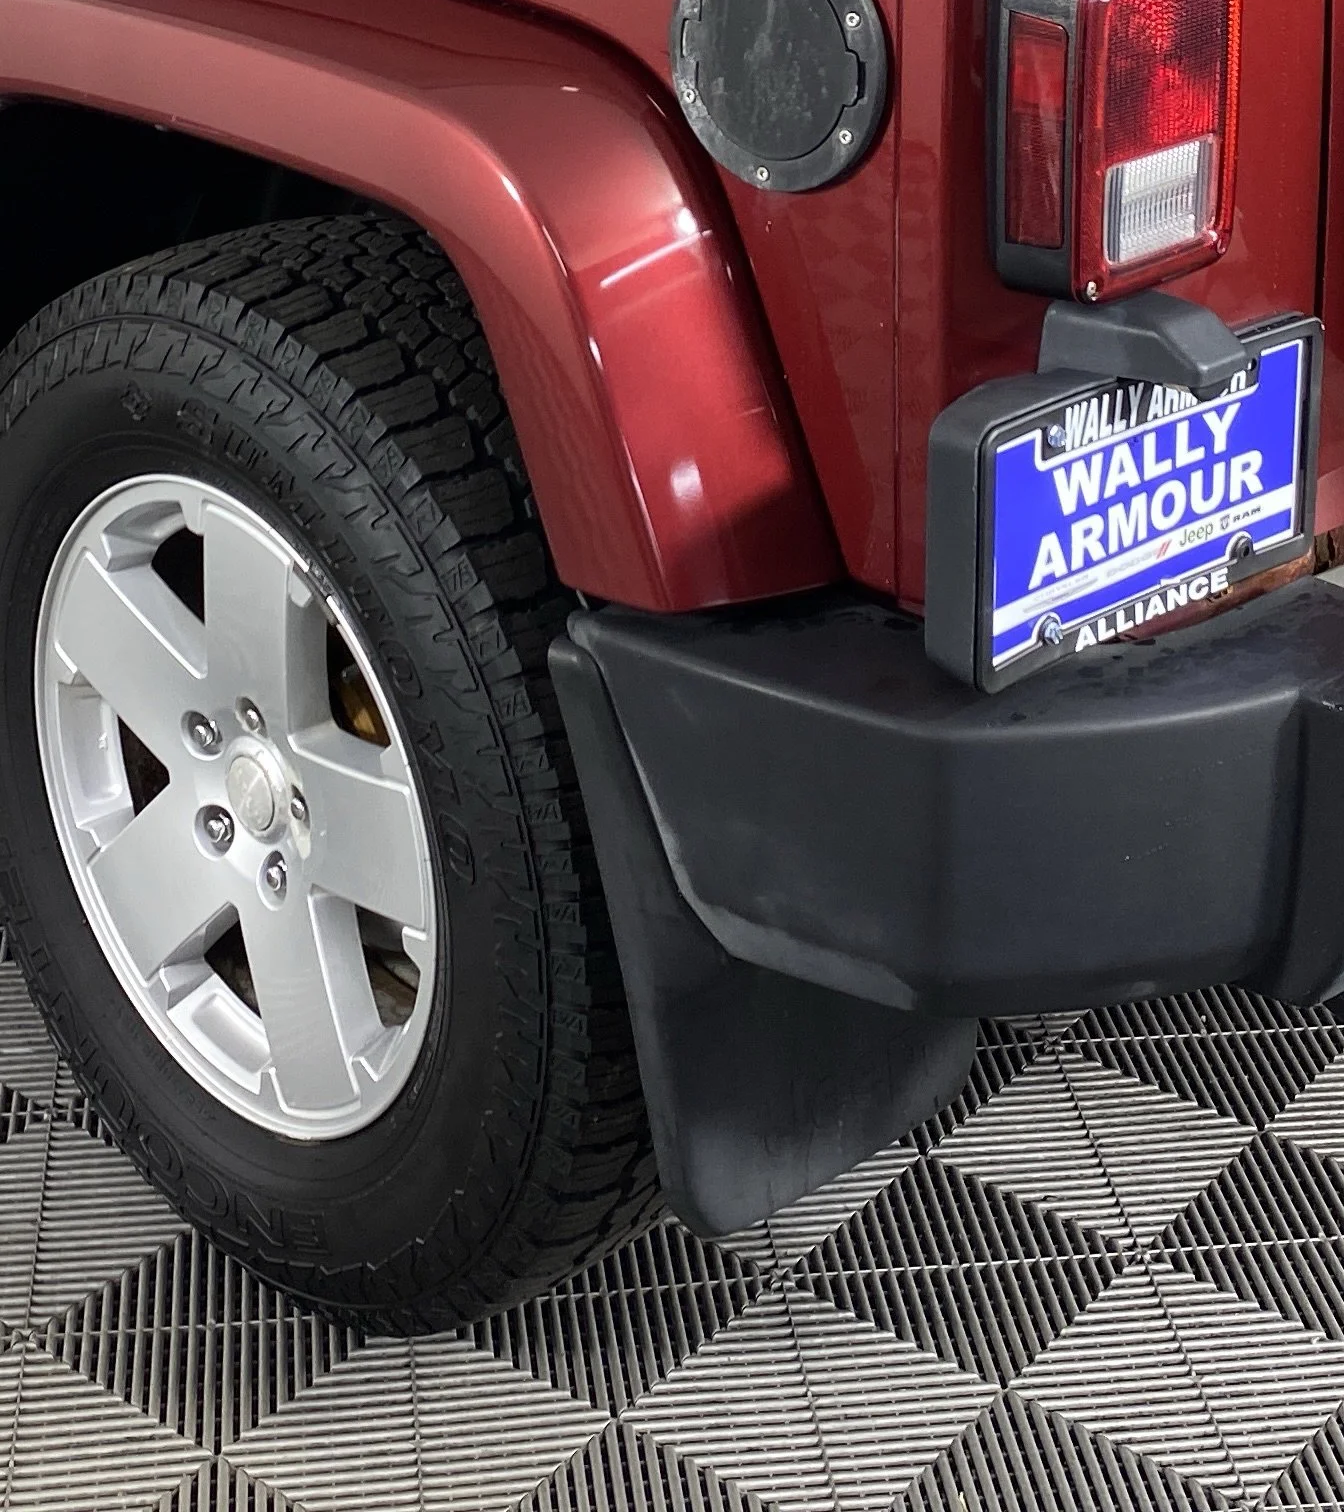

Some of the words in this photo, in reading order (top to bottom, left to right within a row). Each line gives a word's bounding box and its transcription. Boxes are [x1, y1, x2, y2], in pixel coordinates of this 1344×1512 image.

[1065, 382, 1145, 452] WALLY
[1147, 369, 1248, 423] ARMR
[1052, 402, 1242, 516] WALLY
[1027, 450, 1264, 591] ARMOUR
[1179, 521, 1215, 548] Jeep
[1233, 505, 1262, 524] RAM
[1074, 567, 1230, 653] ALLIANCE
